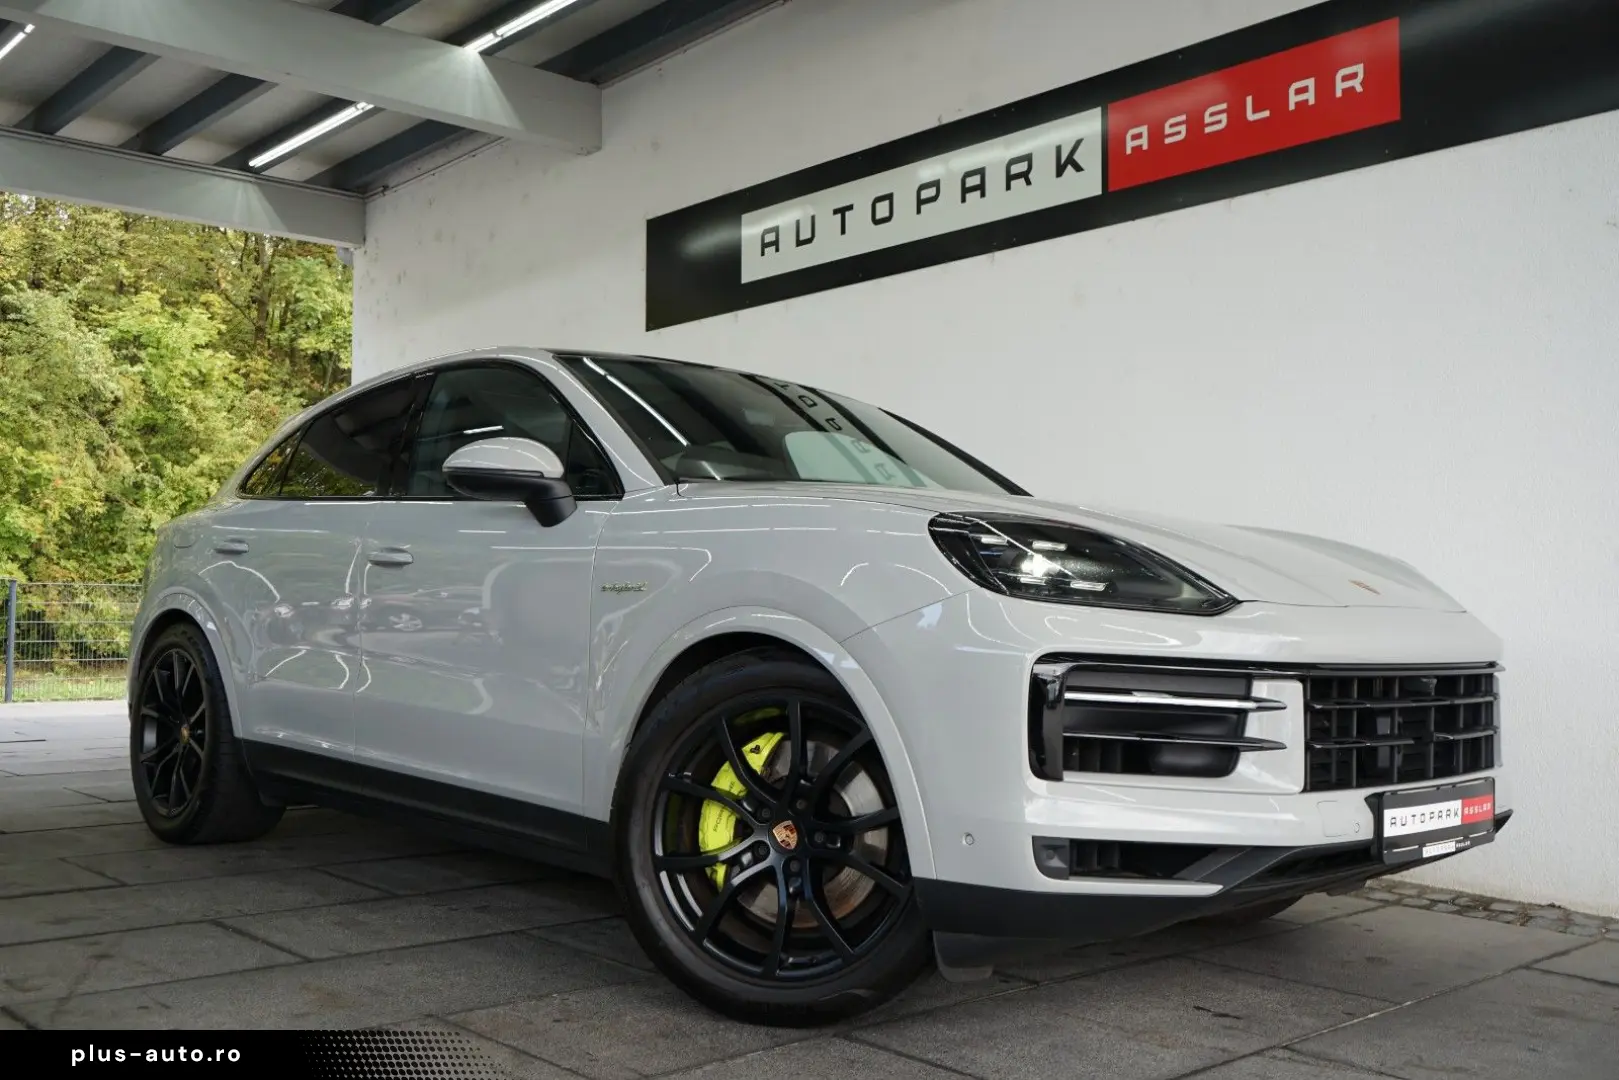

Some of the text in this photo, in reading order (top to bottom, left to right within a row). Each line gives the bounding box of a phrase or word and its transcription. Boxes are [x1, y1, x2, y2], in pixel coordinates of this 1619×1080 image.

[759, 62, 1366, 258] AUTOPARK ASSLAR
[1389, 807, 1460, 828] AUTOPARK
